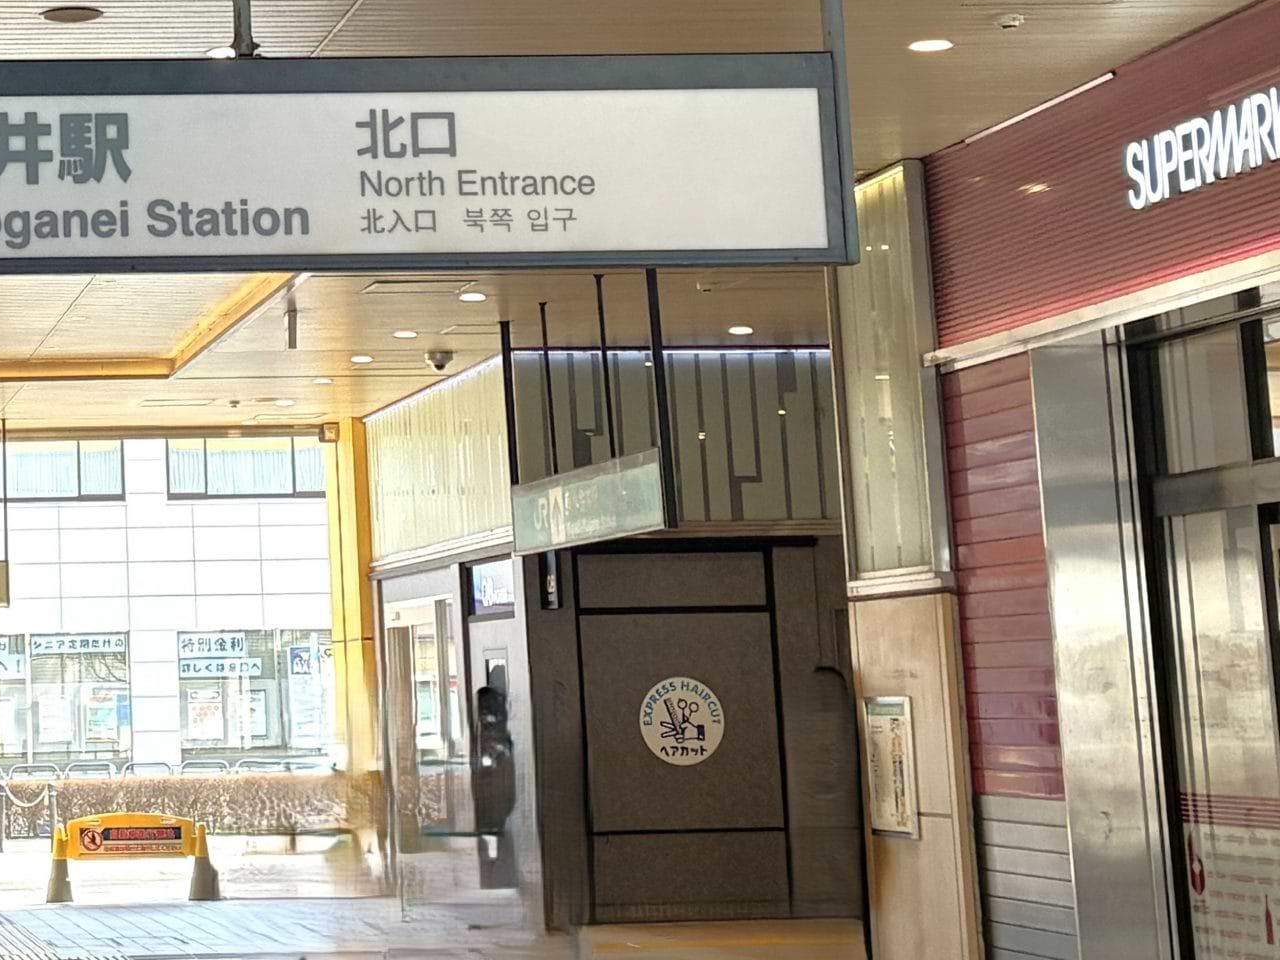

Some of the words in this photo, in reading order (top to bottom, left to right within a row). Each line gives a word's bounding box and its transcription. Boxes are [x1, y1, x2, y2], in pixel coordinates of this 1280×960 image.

[355, 108, 457, 160] 北口
[360, 170, 446, 197] North
[457, 169, 596, 196] Entrance
[145, 198, 311, 237] Station
[360, 208, 438, 234] 北入口
[462, 208, 515, 233] 북쪽
[526, 207, 578, 233] 입구
[33, 638, 124, 650] シニア定期だけの
[181, 637, 244, 653] 特別金利
[643, 681, 678, 727] EXPRESS
[680, 680, 722, 725] HAIRCUT
[660, 745, 708, 757] ヘアカット
